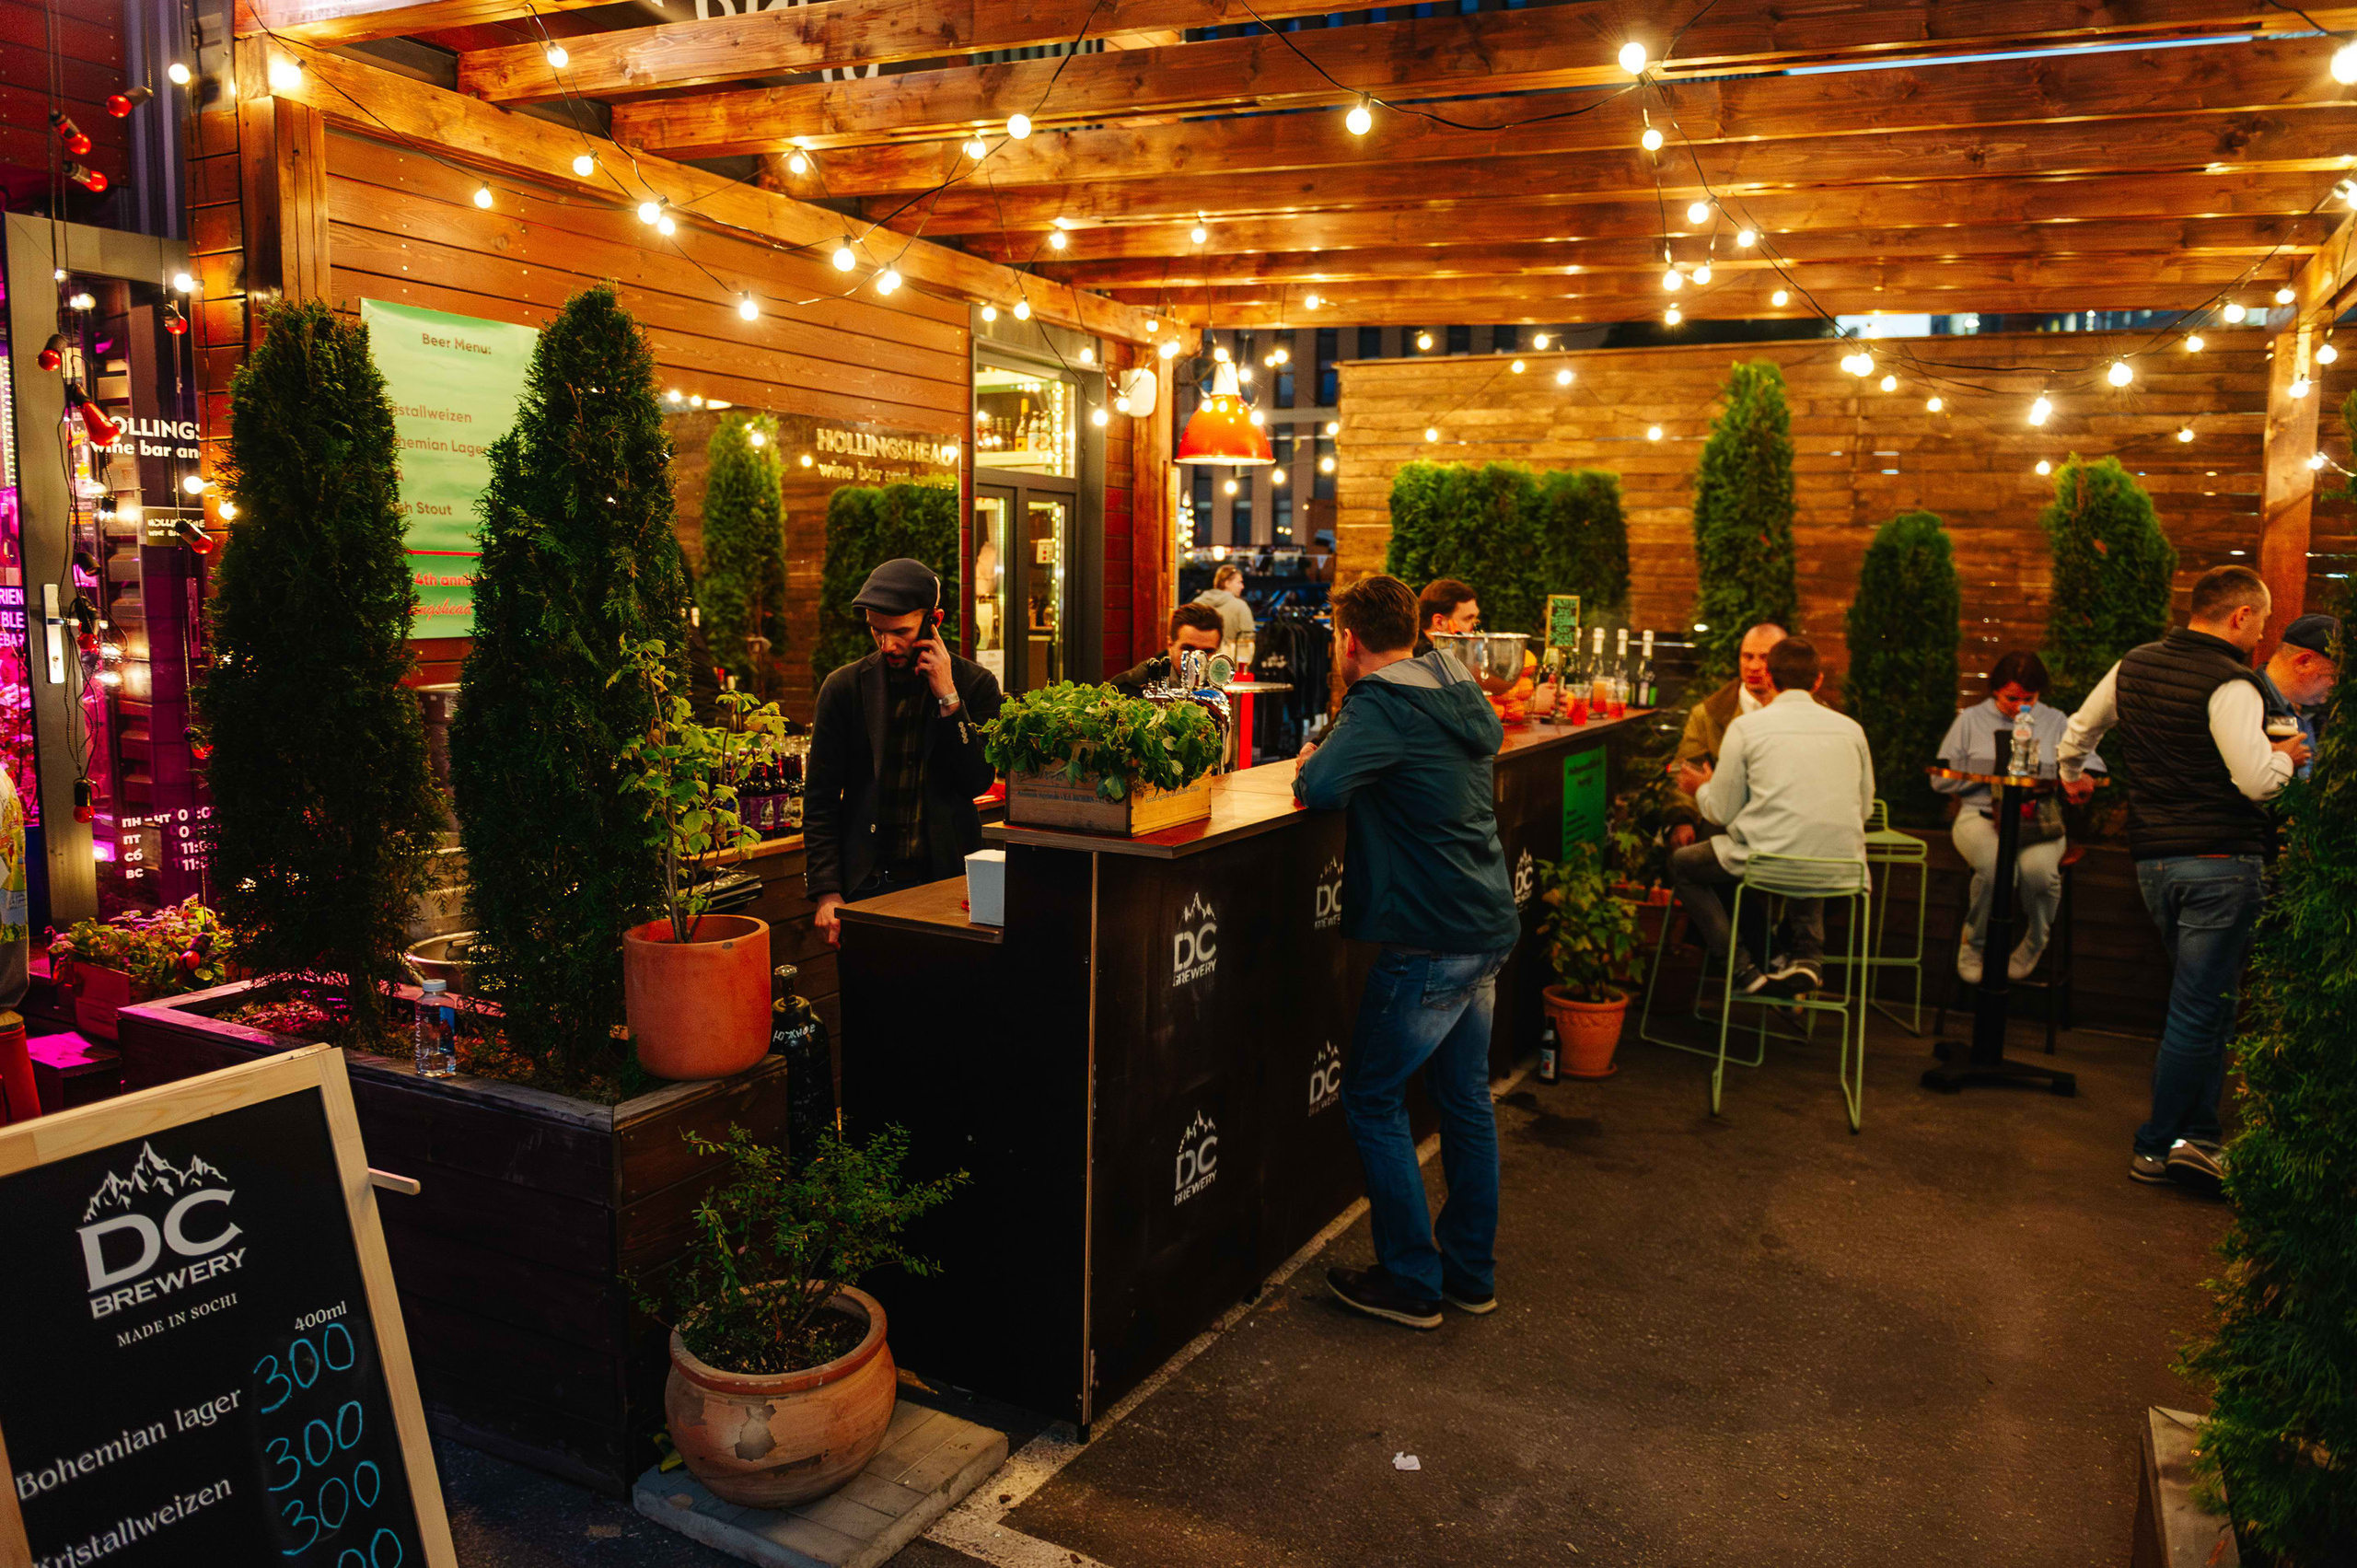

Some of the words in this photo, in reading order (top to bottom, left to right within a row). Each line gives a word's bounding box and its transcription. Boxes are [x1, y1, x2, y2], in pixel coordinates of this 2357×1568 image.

[422, 332, 450, 348] Beer
[454, 337, 492, 354] Menu:
[392, 402, 472, 423] istallweizen
[110, 415, 201, 441] OLLING
[140, 439, 172, 457] bar
[176, 447, 201, 459] an
[397, 435, 448, 452] hemian
[818, 460, 854, 480] wine
[857, 461, 883, 482] bar
[416, 502, 453, 516] Stout
[414, 572, 437, 587] 4th
[440, 573, 470, 587] anni
[123, 834, 141, 845] пт
[123, 848, 144, 863] сб
[126, 868, 144, 879] вс
[1515, 866, 1533, 896] DC
[1174, 922, 1217, 972] DC
[1173, 958, 1216, 987] BREWERY
[1309, 1060, 1341, 1105] DC
[1176, 1135, 1218, 1191] DC
[1174, 1169, 1217, 1206] BREWERY
[75, 1188, 243, 1293] DC
[90, 1247, 247, 1319] BREWERY
[116, 1319, 164, 1347] MADE
[168, 1311, 186, 1329] IN
[191, 1292, 238, 1320] SOCHI
[294, 1300, 348, 1332] 400ml
[16, 1422, 168, 1501] Bohemian
[173, 1388, 241, 1433] lager
[253, 1322, 355, 1414] 300
[265, 1400, 363, 1492] 300
[282, 1460, 380, 1556] 300
